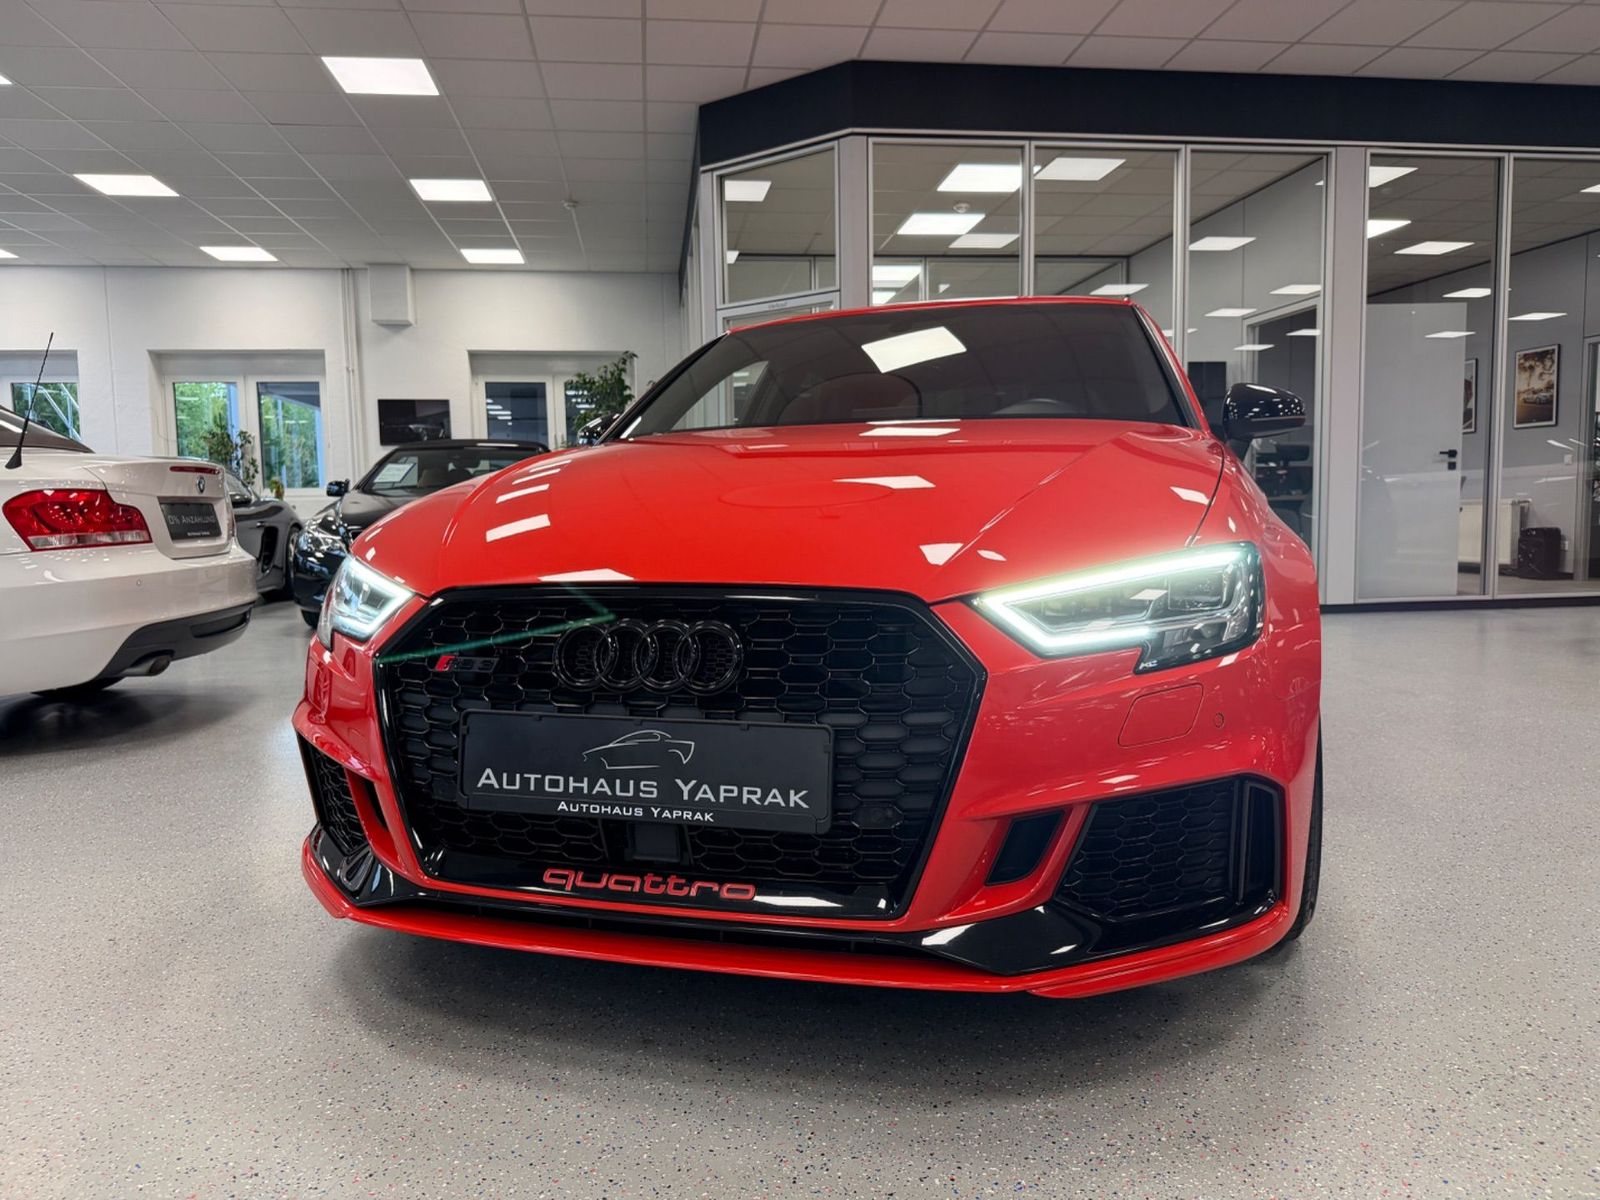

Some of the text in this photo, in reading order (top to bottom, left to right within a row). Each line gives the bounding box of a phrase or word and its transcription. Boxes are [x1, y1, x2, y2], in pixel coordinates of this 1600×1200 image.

[476, 767, 810, 809] AUTOHAUS YAPRAK
[557, 801, 714, 822] AUTOHAUS YAPRAK
[542, 867, 756, 901] quattro
